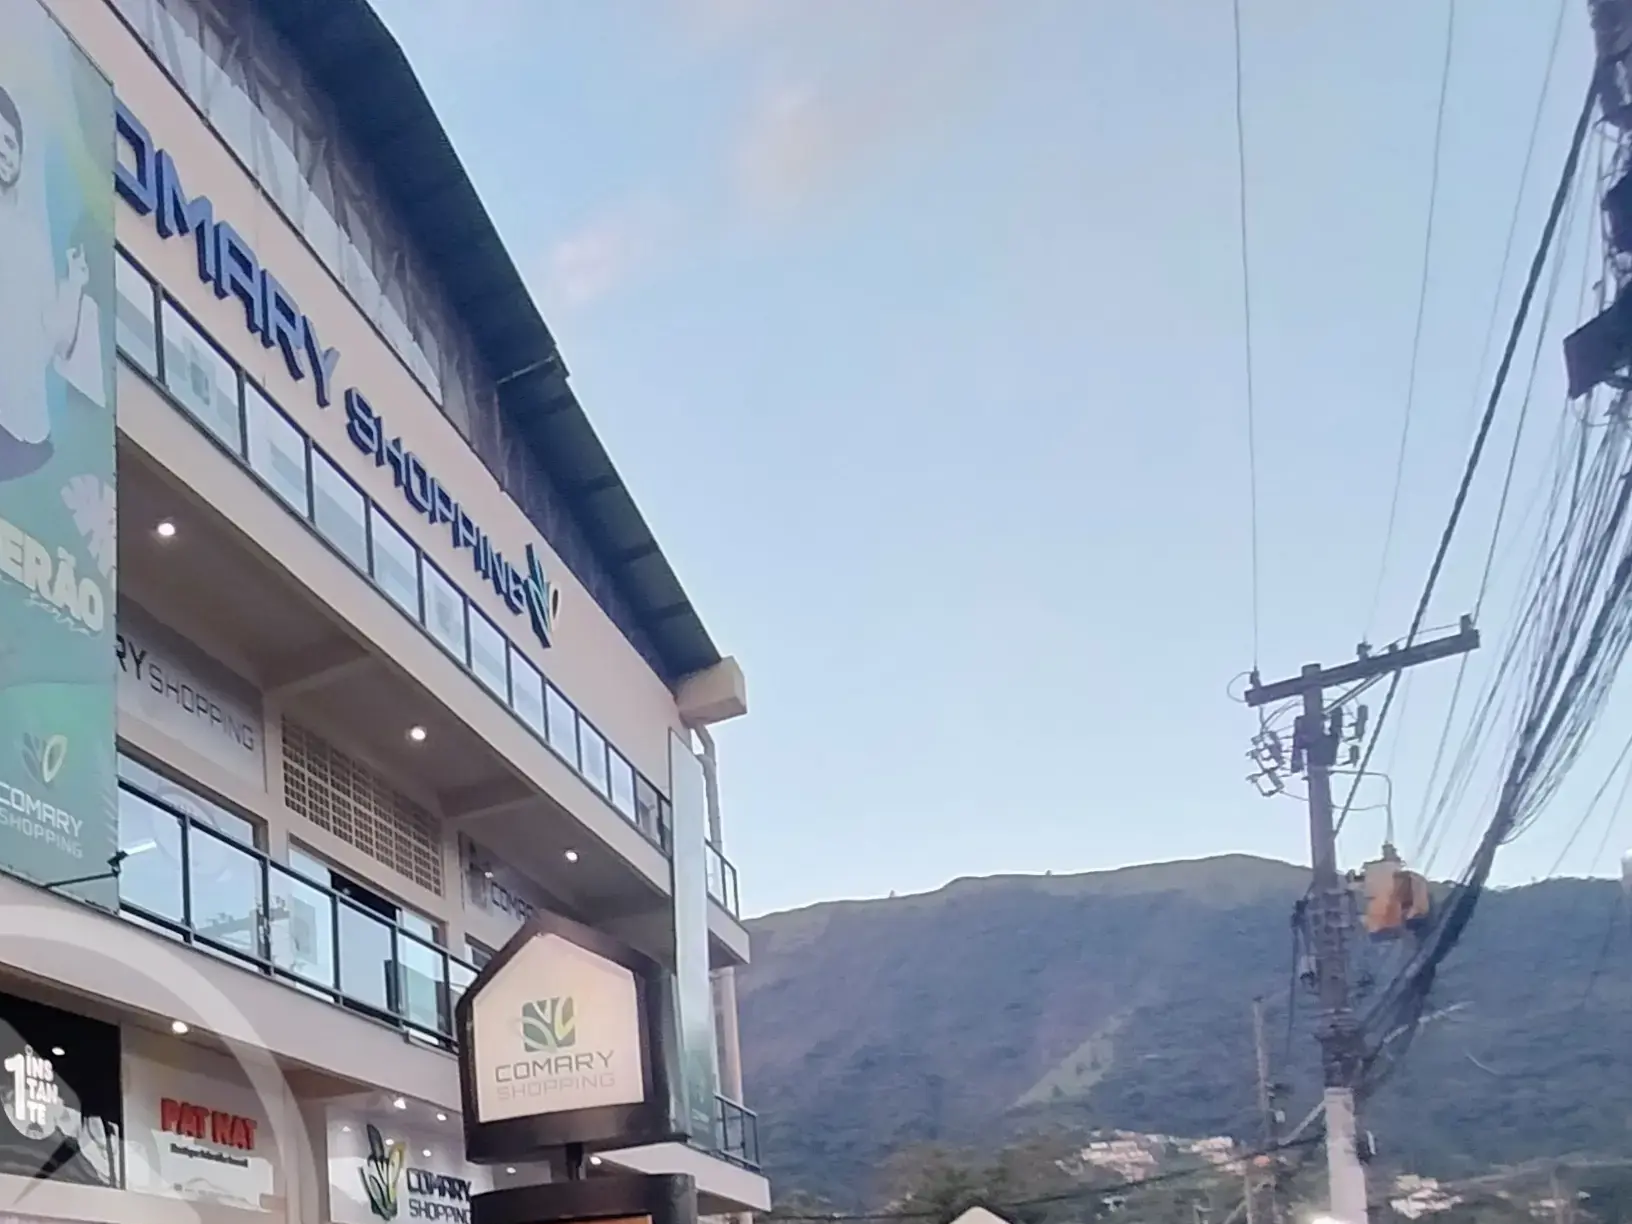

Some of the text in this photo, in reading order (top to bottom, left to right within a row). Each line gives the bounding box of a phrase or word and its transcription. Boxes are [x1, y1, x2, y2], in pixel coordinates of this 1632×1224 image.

[115, 97, 525, 616] OMARY SHOPPING
[149, 663, 255, 752] SHOPPING
[27, 1055, 53, 1082] INS
[495, 1049, 615, 1083] COMARY
[27, 1078, 59, 1105] TAN
[497, 1073, 616, 1101] SHOPPING
[27, 1100, 47, 1125] TE
[161, 1097, 257, 1150] PAT NAT
